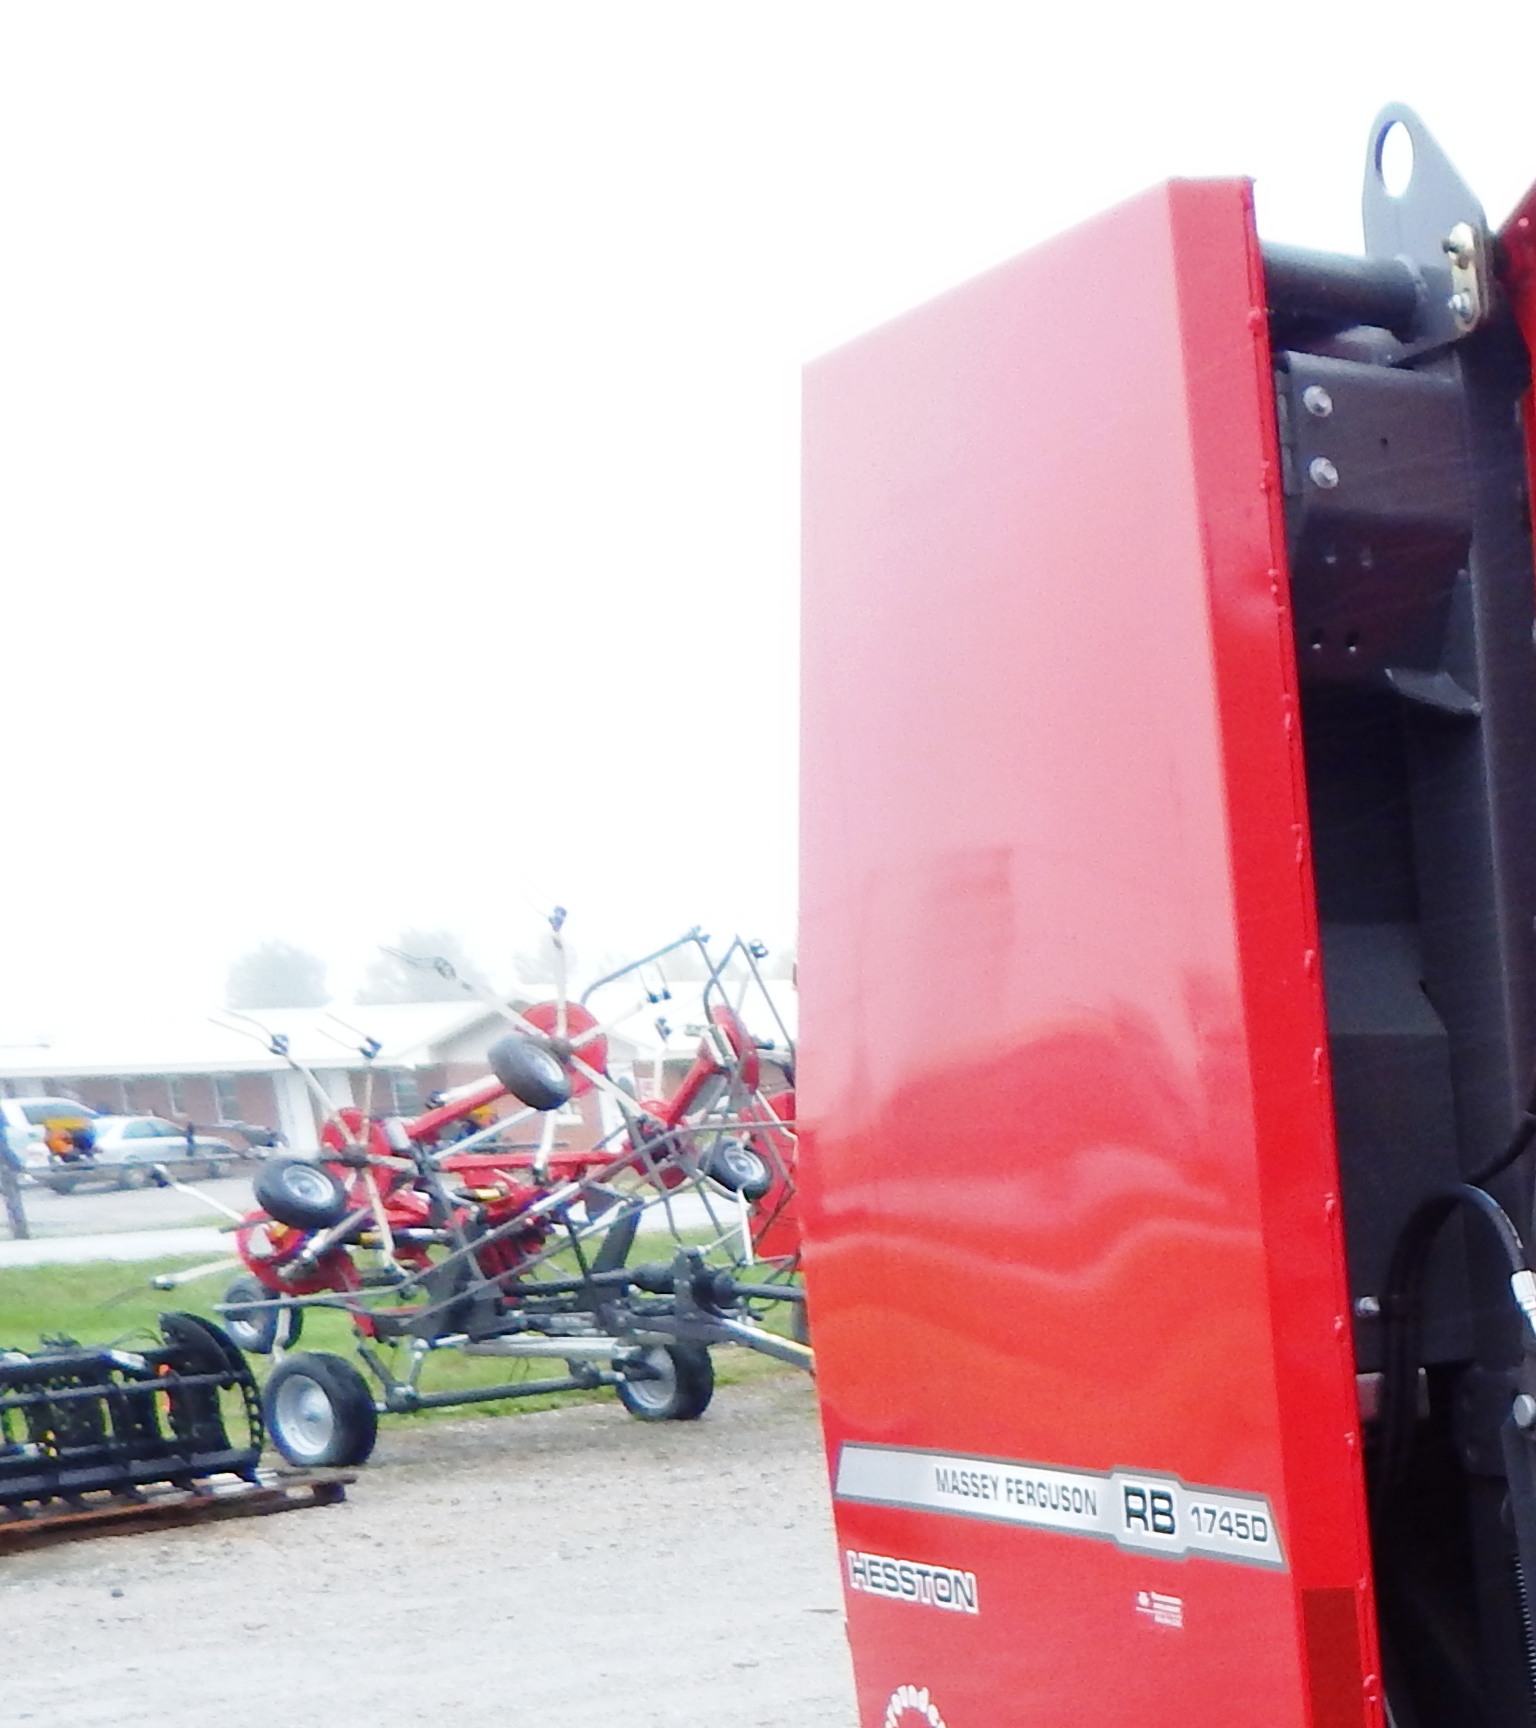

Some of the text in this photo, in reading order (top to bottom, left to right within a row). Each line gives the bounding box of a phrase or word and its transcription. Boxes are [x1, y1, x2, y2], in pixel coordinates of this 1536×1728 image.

[935, 1467, 1269, 1543] MASSEY FERGUSON RB 1745D
[847, 1551, 978, 1612] HESSTON
